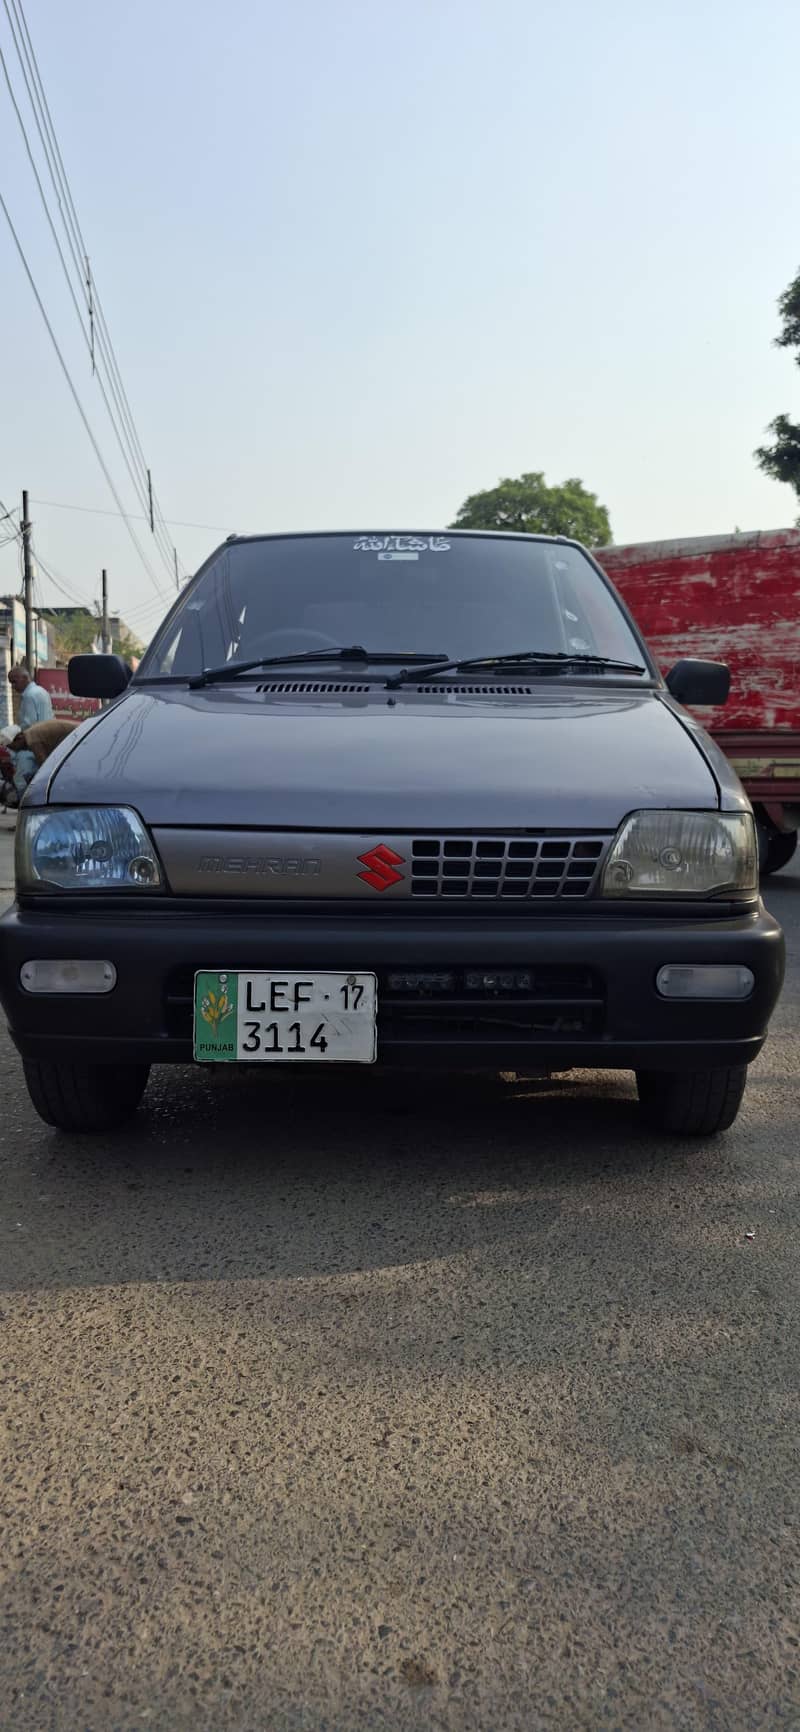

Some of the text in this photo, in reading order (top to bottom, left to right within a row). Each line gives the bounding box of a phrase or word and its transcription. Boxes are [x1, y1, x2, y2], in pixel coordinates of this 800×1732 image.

[197, 855, 321, 875] MEHRAN
[245, 981, 365, 1012] LEF 17
[199, 1043, 235, 1052] PUNJAB
[242, 1021, 329, 1053] 3114
